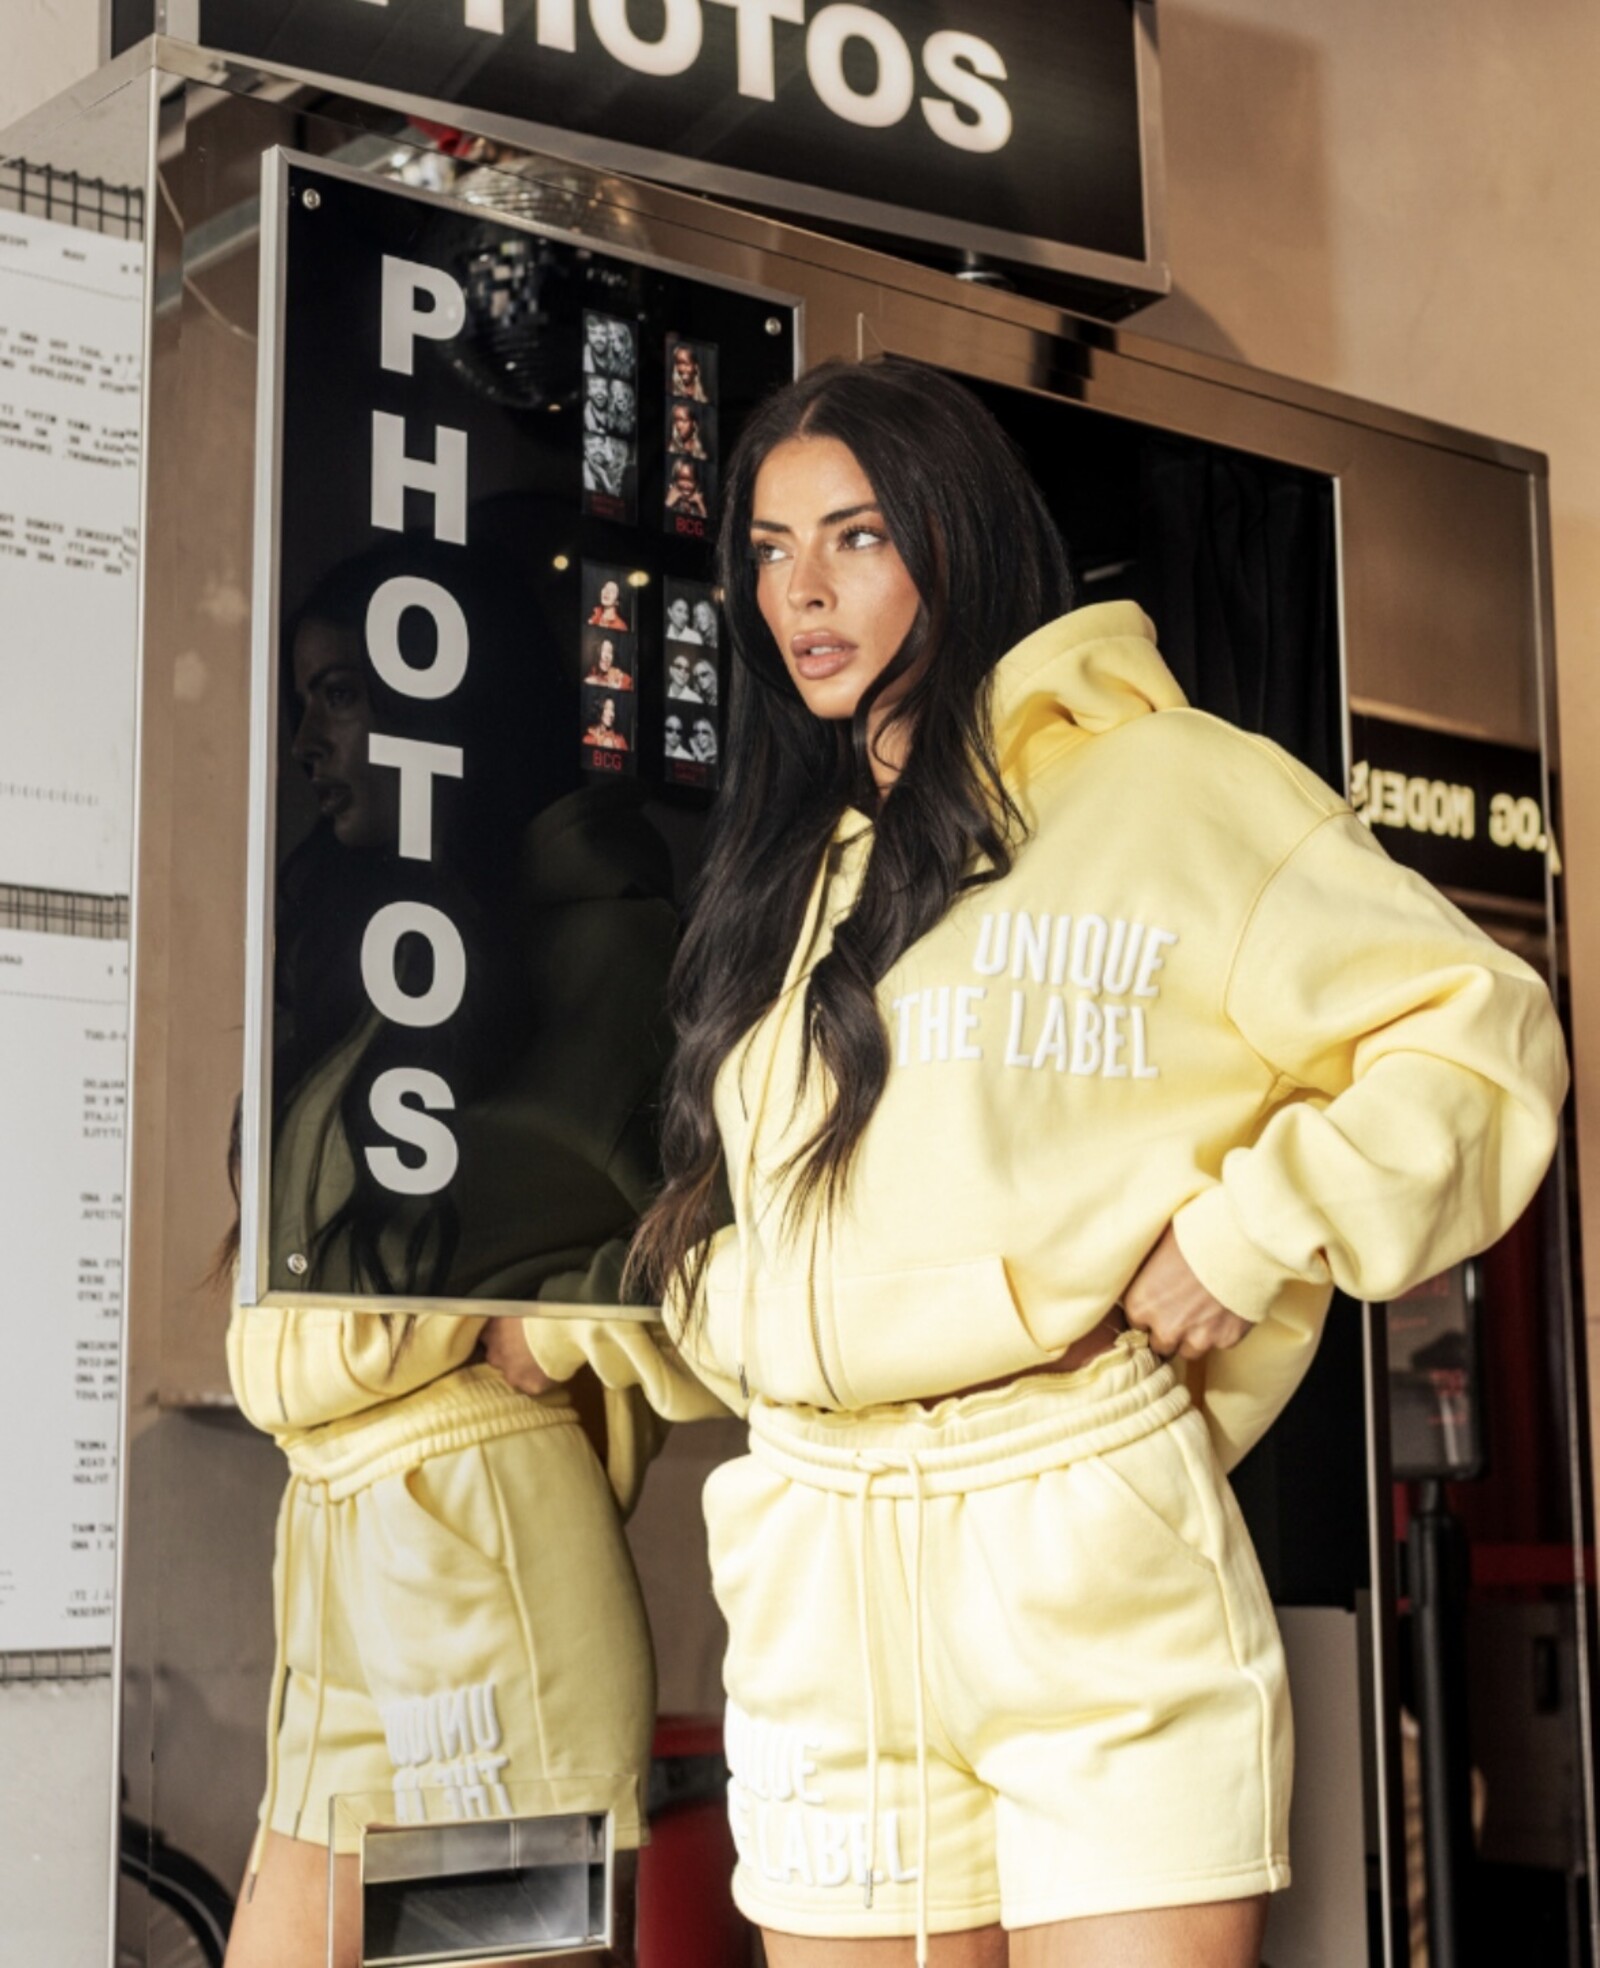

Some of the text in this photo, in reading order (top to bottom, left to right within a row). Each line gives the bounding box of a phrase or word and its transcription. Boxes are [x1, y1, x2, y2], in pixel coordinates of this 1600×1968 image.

[348, 0, 1013, 153] OTOS
[360, 254, 469, 1195] PHOTOS
[592, 749, 623, 771] BCG
[972, 911, 1180, 998] UNIQUE
[892, 984, 1160, 1079] THE LABEL
